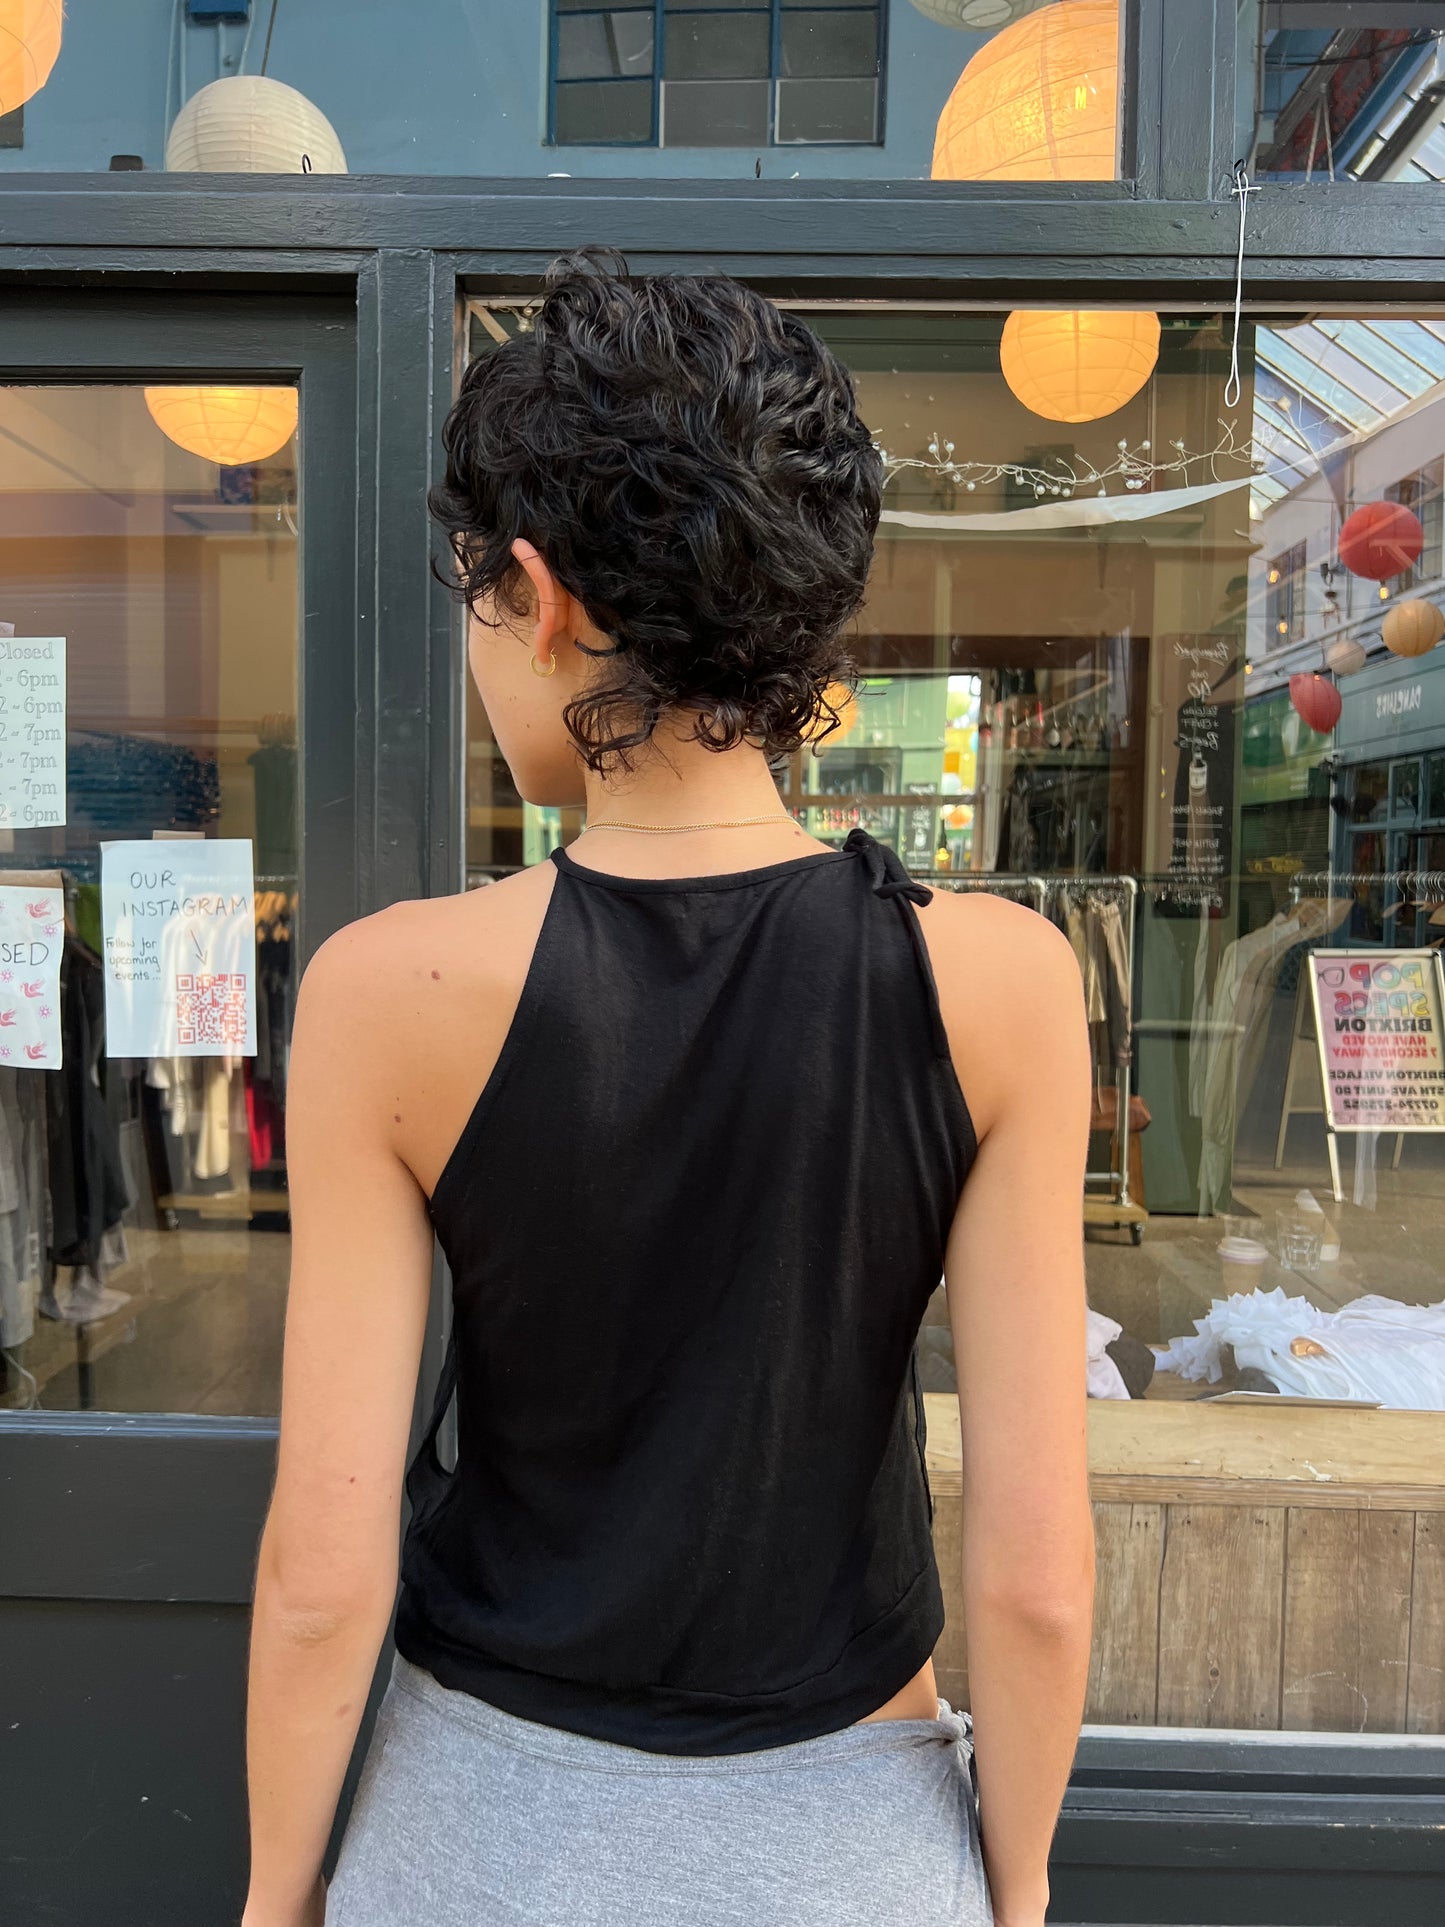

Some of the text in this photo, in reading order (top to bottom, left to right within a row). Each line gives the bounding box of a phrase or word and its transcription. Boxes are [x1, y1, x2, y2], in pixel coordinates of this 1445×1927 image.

[17, 669, 59, 691] 6pm
[24, 696, 63, 719] 6pm
[24, 723, 61, 746] 7pm
[20, 752, 58, 773] 7pm
[22, 778, 58, 800] 7pm
[23, 804, 60, 828] 6pm
[130, 870, 176, 889] OUR
[122, 897, 248, 917] INSTAGRAM
[106, 937, 157, 956] Follow for
[109, 956, 161, 972] upcoming
